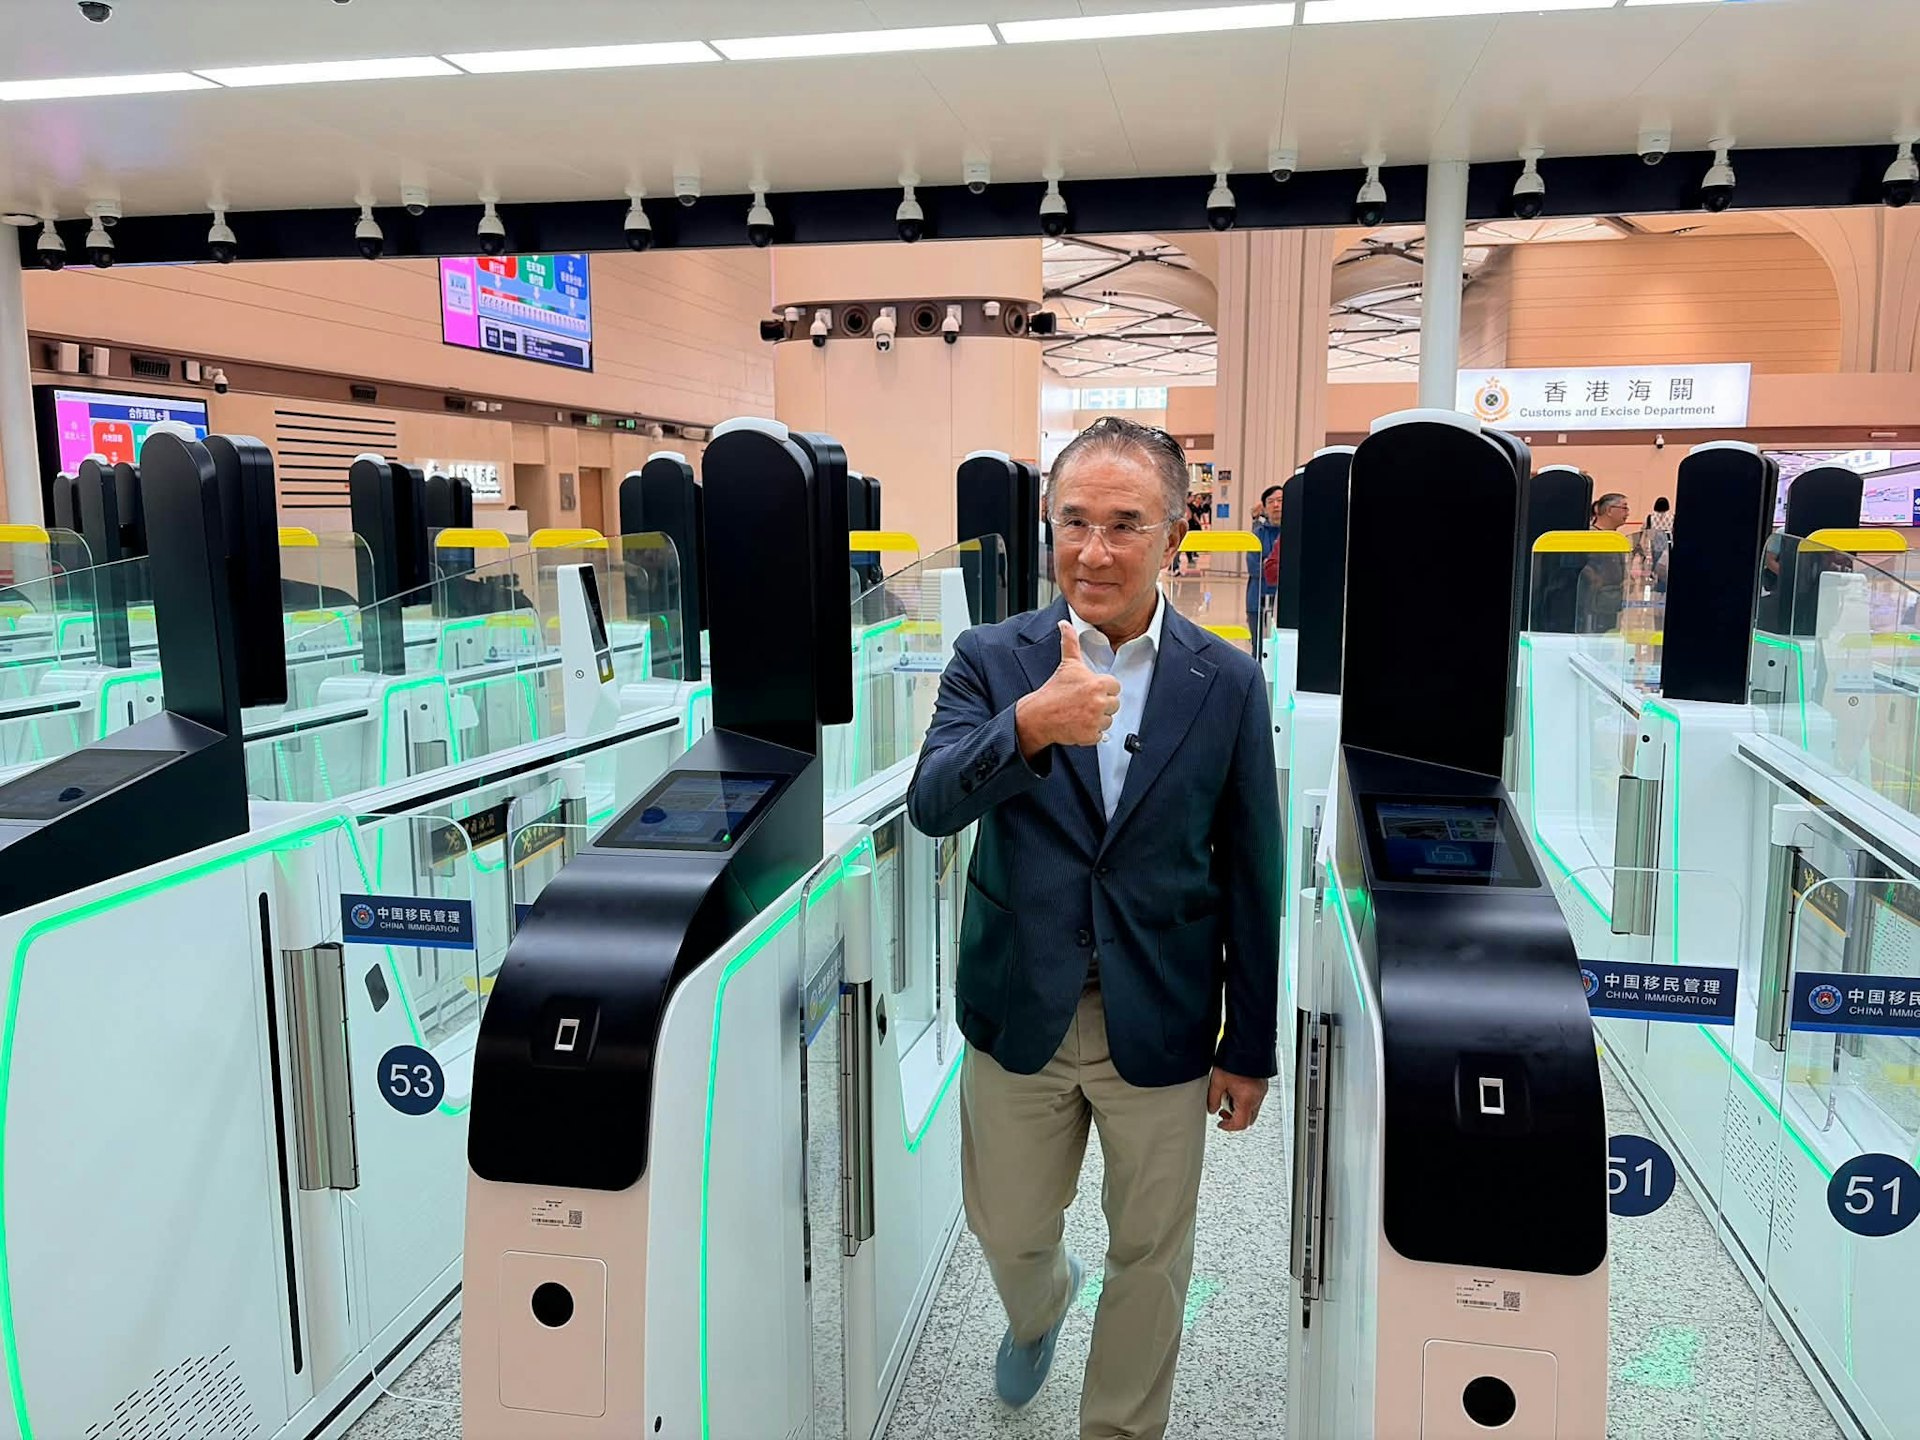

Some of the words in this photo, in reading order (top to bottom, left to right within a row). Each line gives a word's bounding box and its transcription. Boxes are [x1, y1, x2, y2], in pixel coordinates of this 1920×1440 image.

[1544, 378, 1694, 402] 香港海關
[1520, 408, 1572, 418] Customs
[1575, 407, 1598, 417] and
[1600, 406, 1641, 417] Excise
[1644, 405, 1716, 417] Department
[377, 906, 461, 924] 中国移民管理
[379, 921, 405, 930] CHINA
[408, 924, 460, 933] IMMIGRATION
[1604, 972, 1721, 995] 中国移民管理
[1605, 990, 1639, 1001] CHINA
[1644, 993, 1717, 1006] IMMIGRATION
[1849, 1006, 1884, 1016] CHINA
[390, 1063, 435, 1098] 53
[1608, 1156, 1653, 1197] 51
[1843, 1175, 1901, 1216] 51
